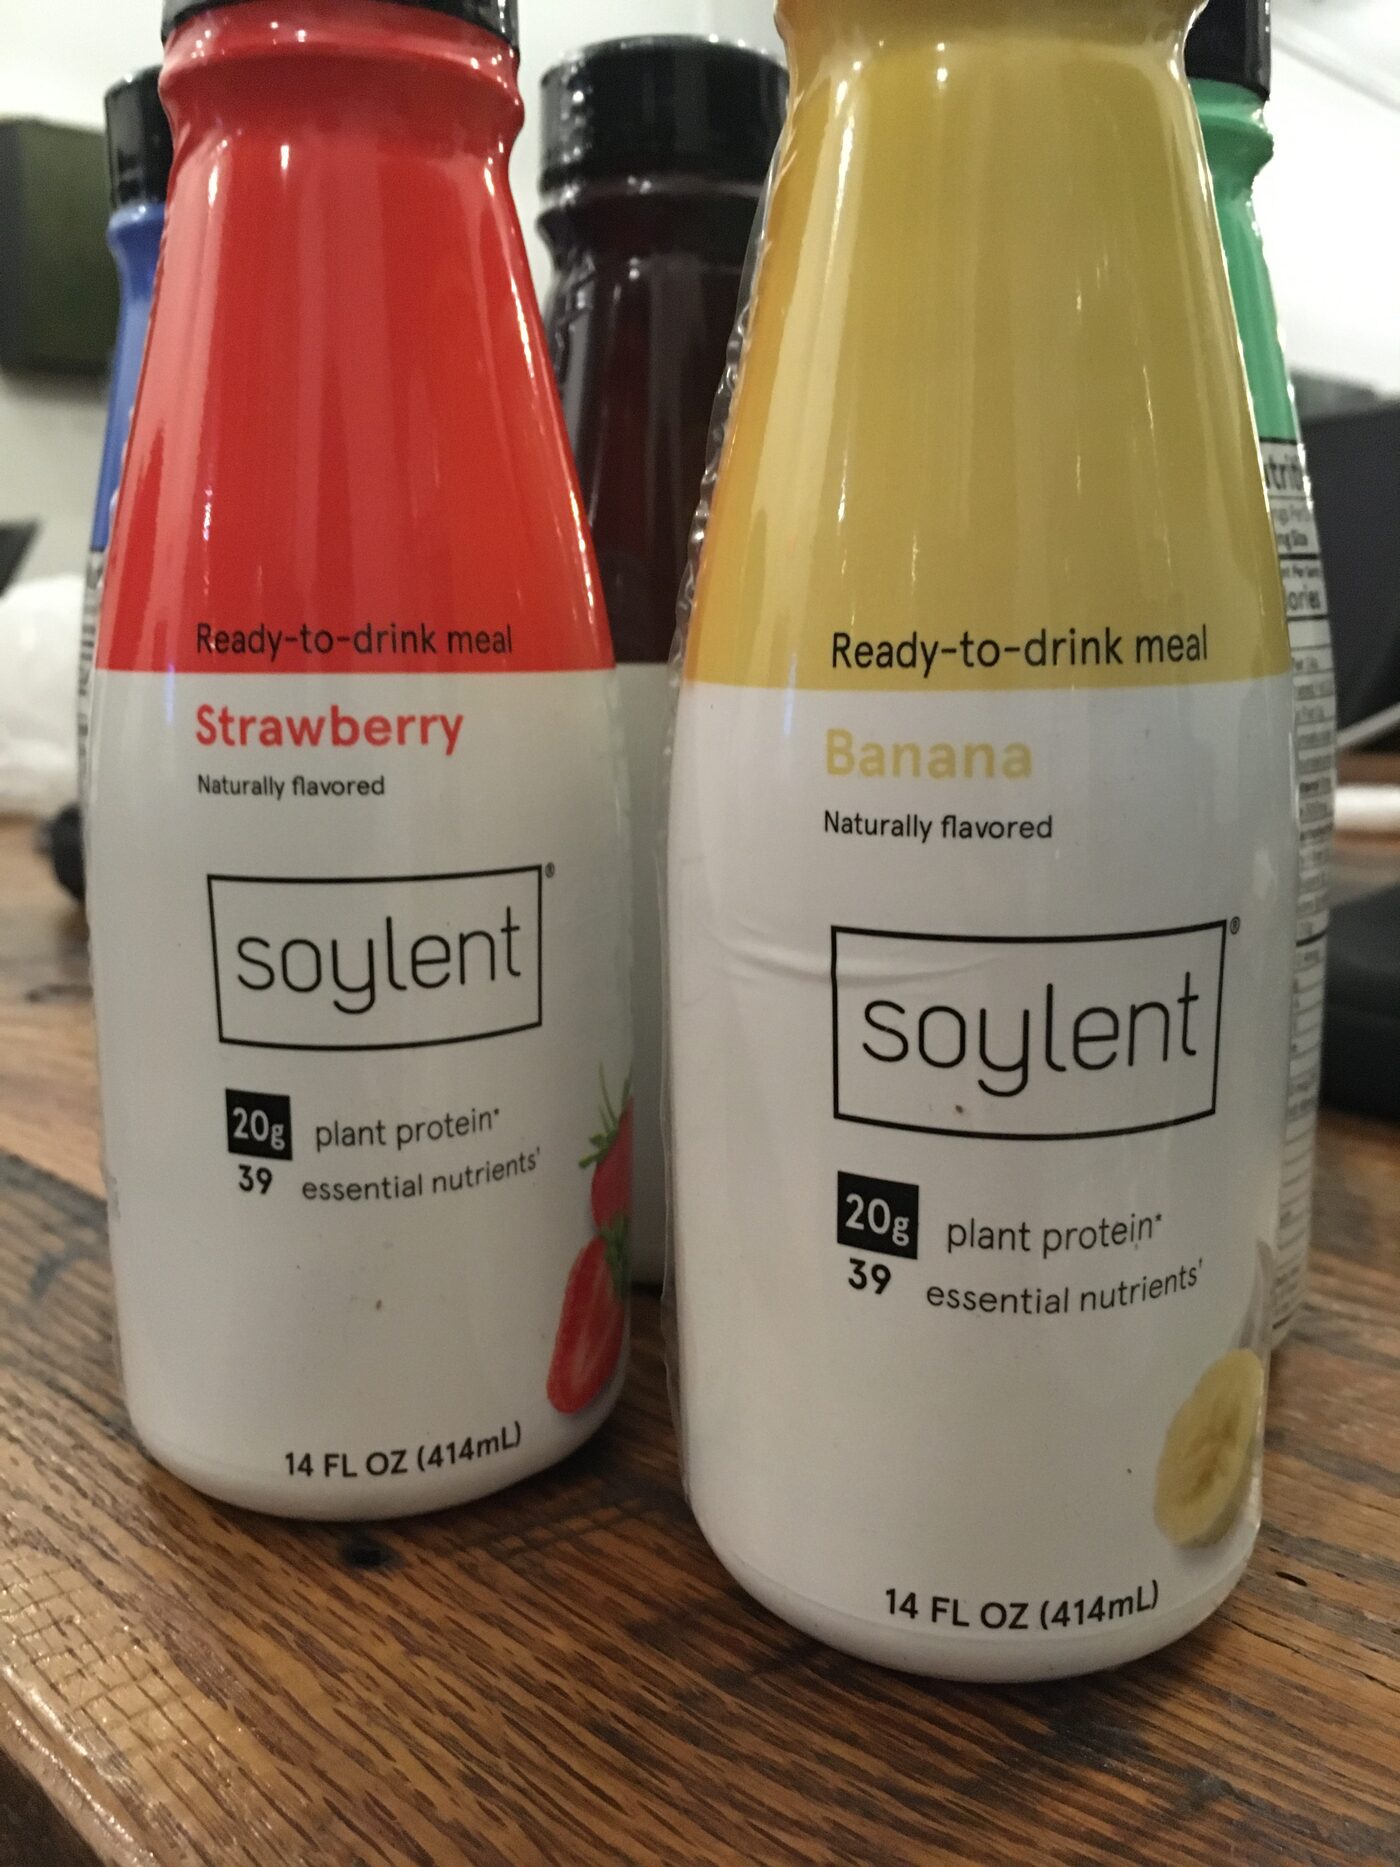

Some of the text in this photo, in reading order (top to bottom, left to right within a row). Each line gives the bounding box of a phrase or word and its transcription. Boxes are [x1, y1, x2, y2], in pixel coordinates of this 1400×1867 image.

[196, 623, 512, 662] Ready-to-drink meal
[832, 624, 1208, 678] Ready-to-drink meal
[195, 703, 464, 756] Strawberry
[825, 728, 1033, 779] Banana
[198, 775, 385, 800] Naturally flavored
[824, 810, 1053, 843] Naturally flavored
[237, 905, 521, 1014] soylent
[862, 971, 1199, 1097] soylent
[232, 1107, 285, 1150] 20g
[315, 1120, 387, 1152] plant
[238, 1164, 273, 1194] 39
[302, 1174, 423, 1201] essential
[844, 1193, 910, 1247] 20g
[946, 1217, 1031, 1254] plant
[847, 1258, 892, 1295] 39
[926, 1285, 1069, 1315] essential
[285, 1421, 522, 1477] 14 FL OZ (414mL)
[885, 1580, 1159, 1631] 14 FL OZ (414mL)
